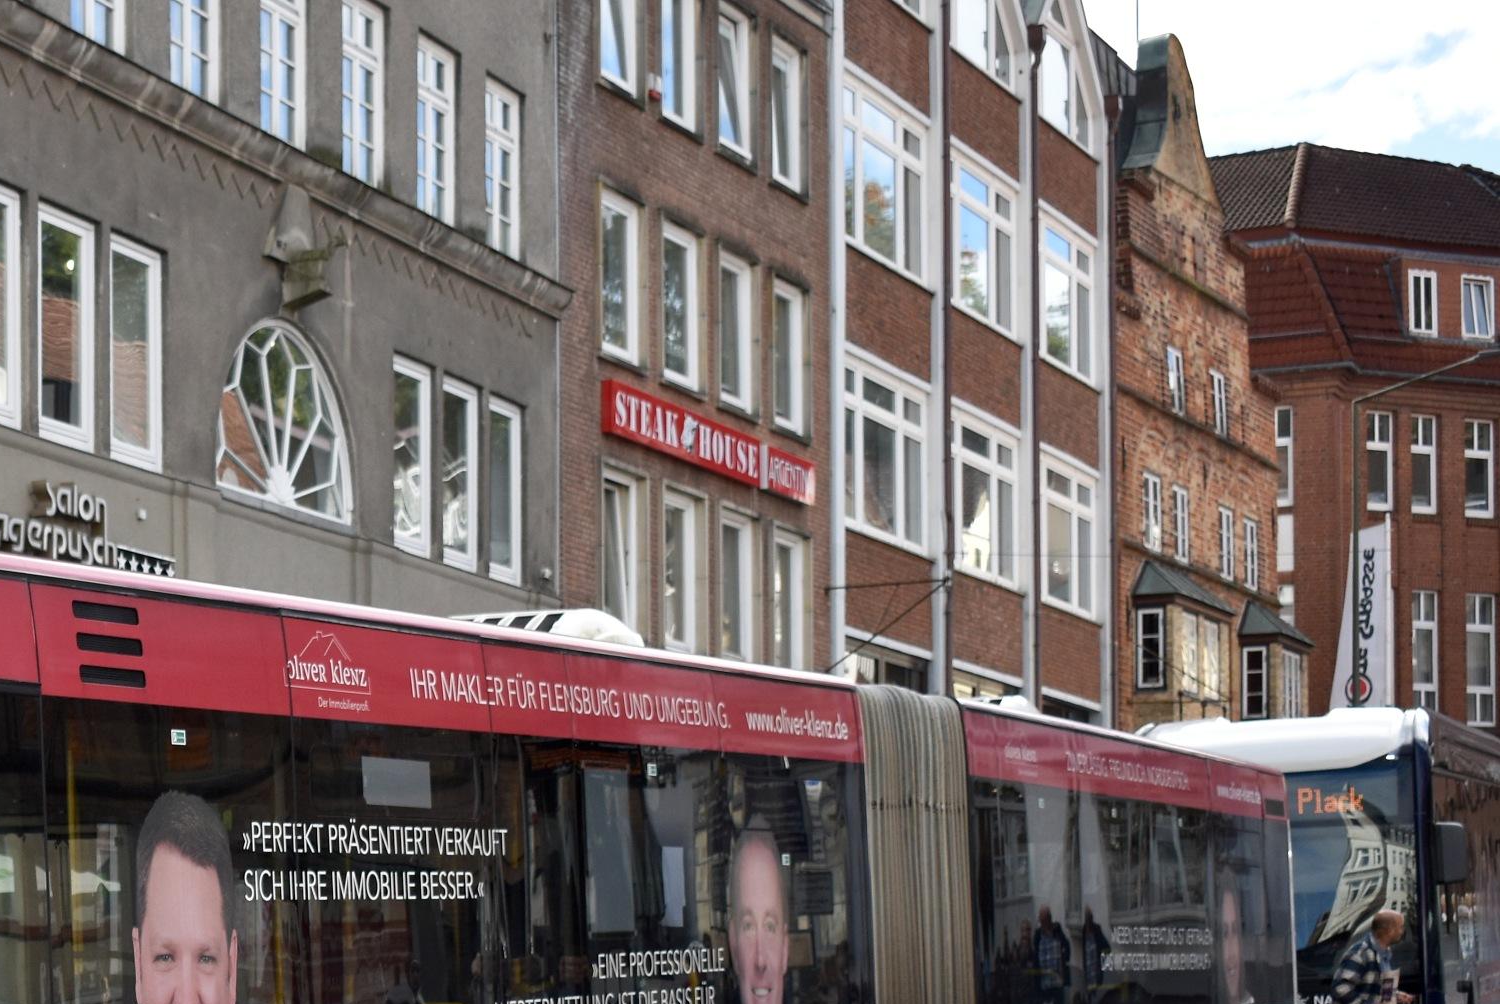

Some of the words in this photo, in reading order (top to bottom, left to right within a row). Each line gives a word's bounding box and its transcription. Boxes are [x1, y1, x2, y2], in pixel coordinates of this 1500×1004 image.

[615, 391, 678, 448] STEAK
[699, 420, 758, 479] HOUSE
[317, 696, 328, 708] Der
[410, 668, 437, 701] IHR
[441, 672, 504, 707] MAKLER
[507, 672, 537, 710] FÜR
[539, 680, 620, 719] FLENSBURG
[624, 691, 653, 722] UND
[657, 695, 731, 729] UMGEBUNG.
[745, 708, 849, 741] www.oliver-klenz.de
[328, 818, 432, 855] PRÄSENTIERT
[435, 827, 508, 857] VERKAUFT
[243, 869, 285, 901] SICH
[289, 869, 328, 901] IHRE
[332, 869, 417, 900] IMMOBILIE
[420, 871, 485, 900] BESSER.«
[629, 947, 726, 978] PROFESSIONELLE
